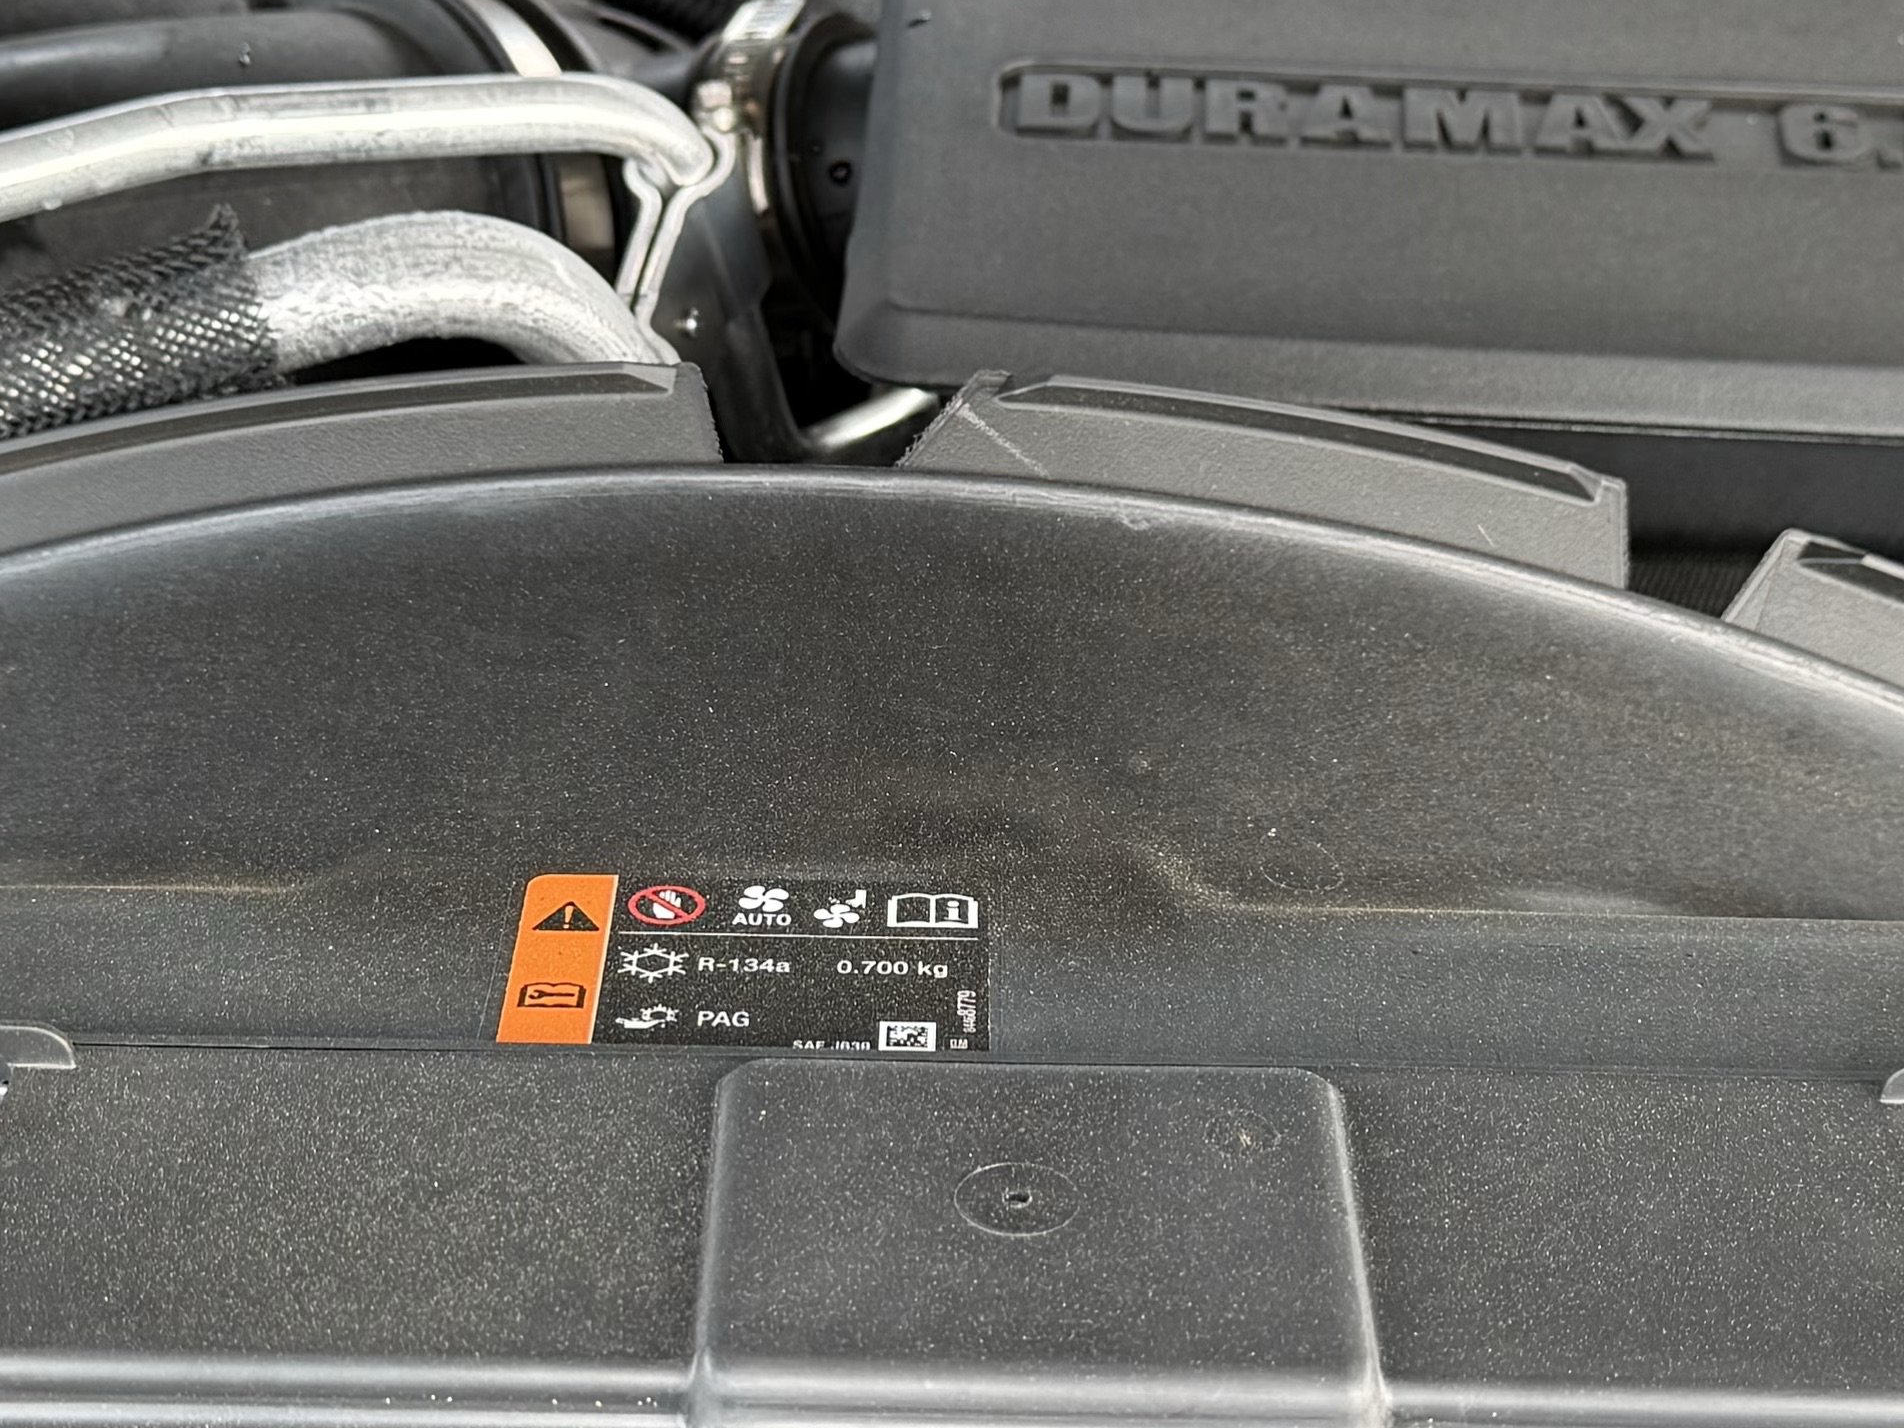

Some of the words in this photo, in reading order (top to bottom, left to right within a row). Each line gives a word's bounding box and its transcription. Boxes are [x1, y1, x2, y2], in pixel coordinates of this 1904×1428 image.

[1012, 72, 1714, 164] DURAMAX
[732, 913, 792, 926] AUTO
[698, 957, 791, 973] R-134a
[836, 960, 909, 975] 0.700
[918, 961, 948, 978] kg
[697, 1010, 750, 1027] PAG
